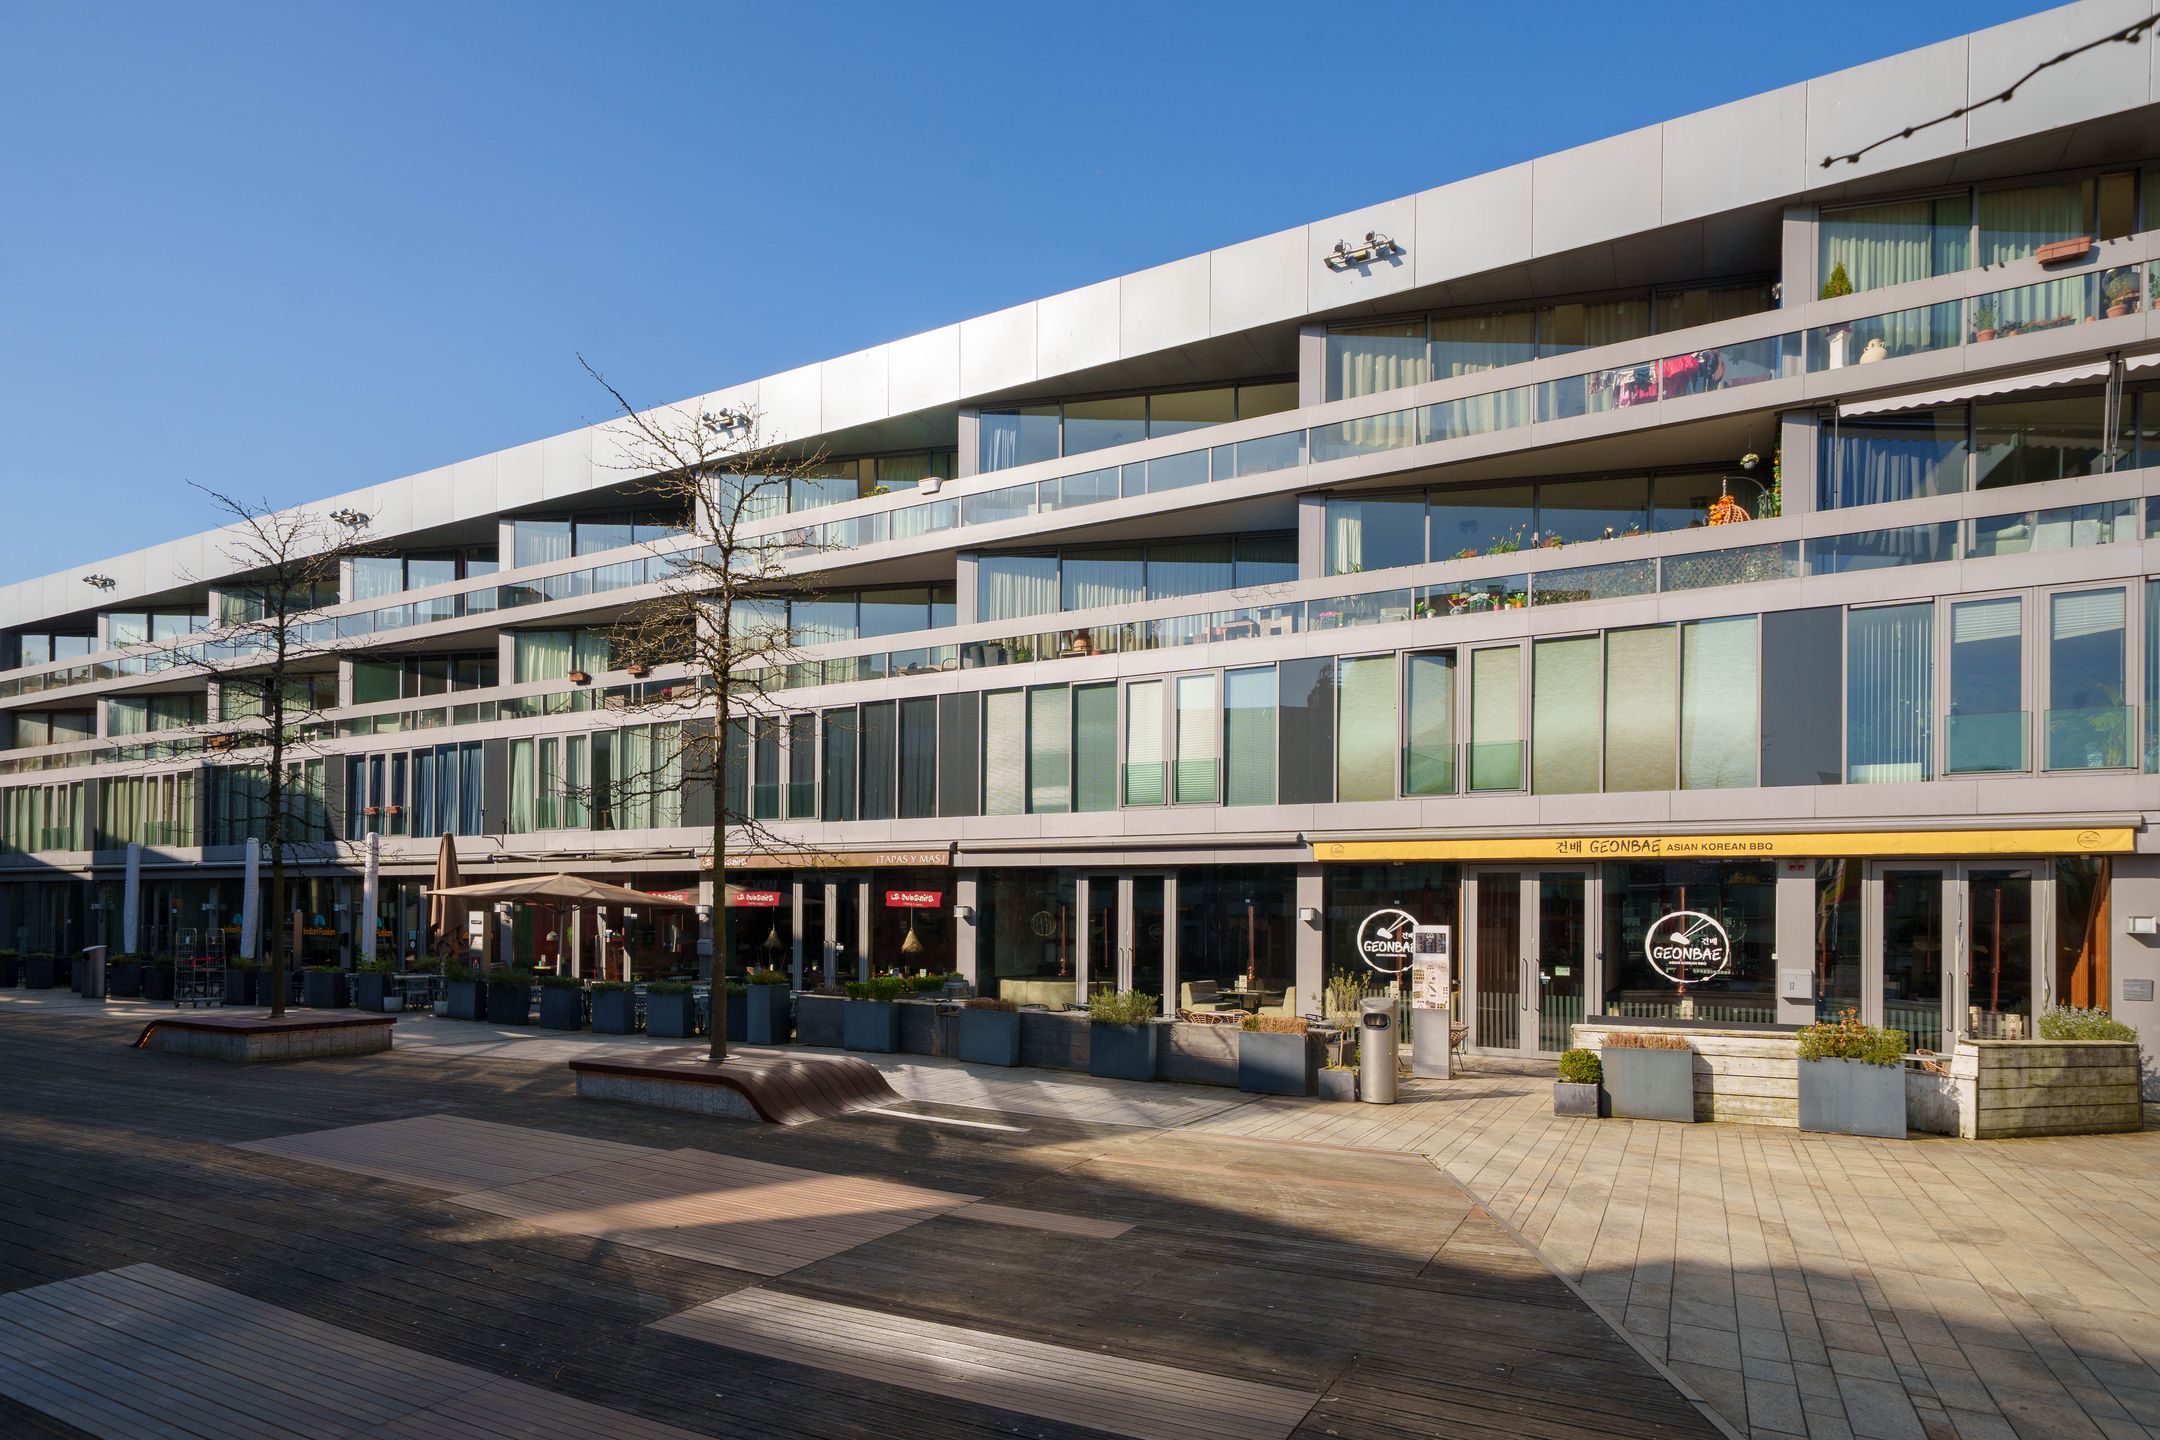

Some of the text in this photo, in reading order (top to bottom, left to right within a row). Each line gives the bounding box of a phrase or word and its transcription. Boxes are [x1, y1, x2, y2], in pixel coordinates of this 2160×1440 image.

[1556, 840, 1582, 854] 건배
[1590, 839, 1773, 853] GEONBAE ASIAN KOREAN BBQ
[1653, 946, 1723, 961] GEONBAE
